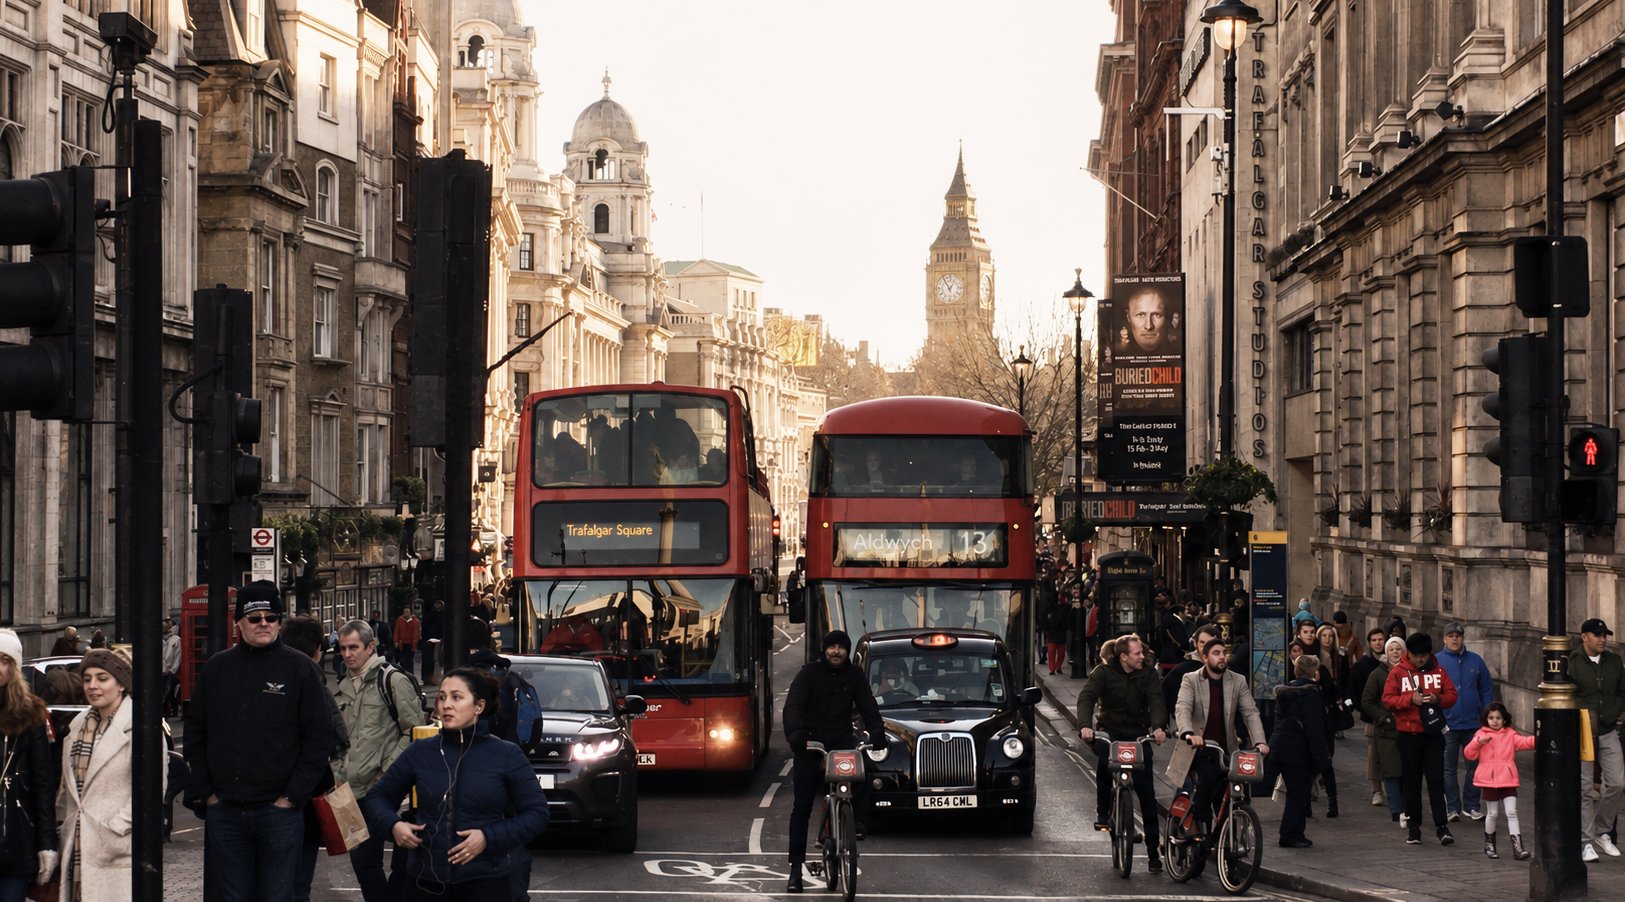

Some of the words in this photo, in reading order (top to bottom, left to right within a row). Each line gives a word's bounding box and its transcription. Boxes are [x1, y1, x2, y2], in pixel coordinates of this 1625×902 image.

[1251, 32, 1266, 263] TRAFALGAR
[1251, 280, 1267, 458] STUDIOS
[567, 524, 613, 538] Trafalgar
[616, 524, 653, 538] Square
[853, 532, 933, 554] Aldwych
[961, 531, 988, 554] 13
[922, 797, 950, 808] LR64
